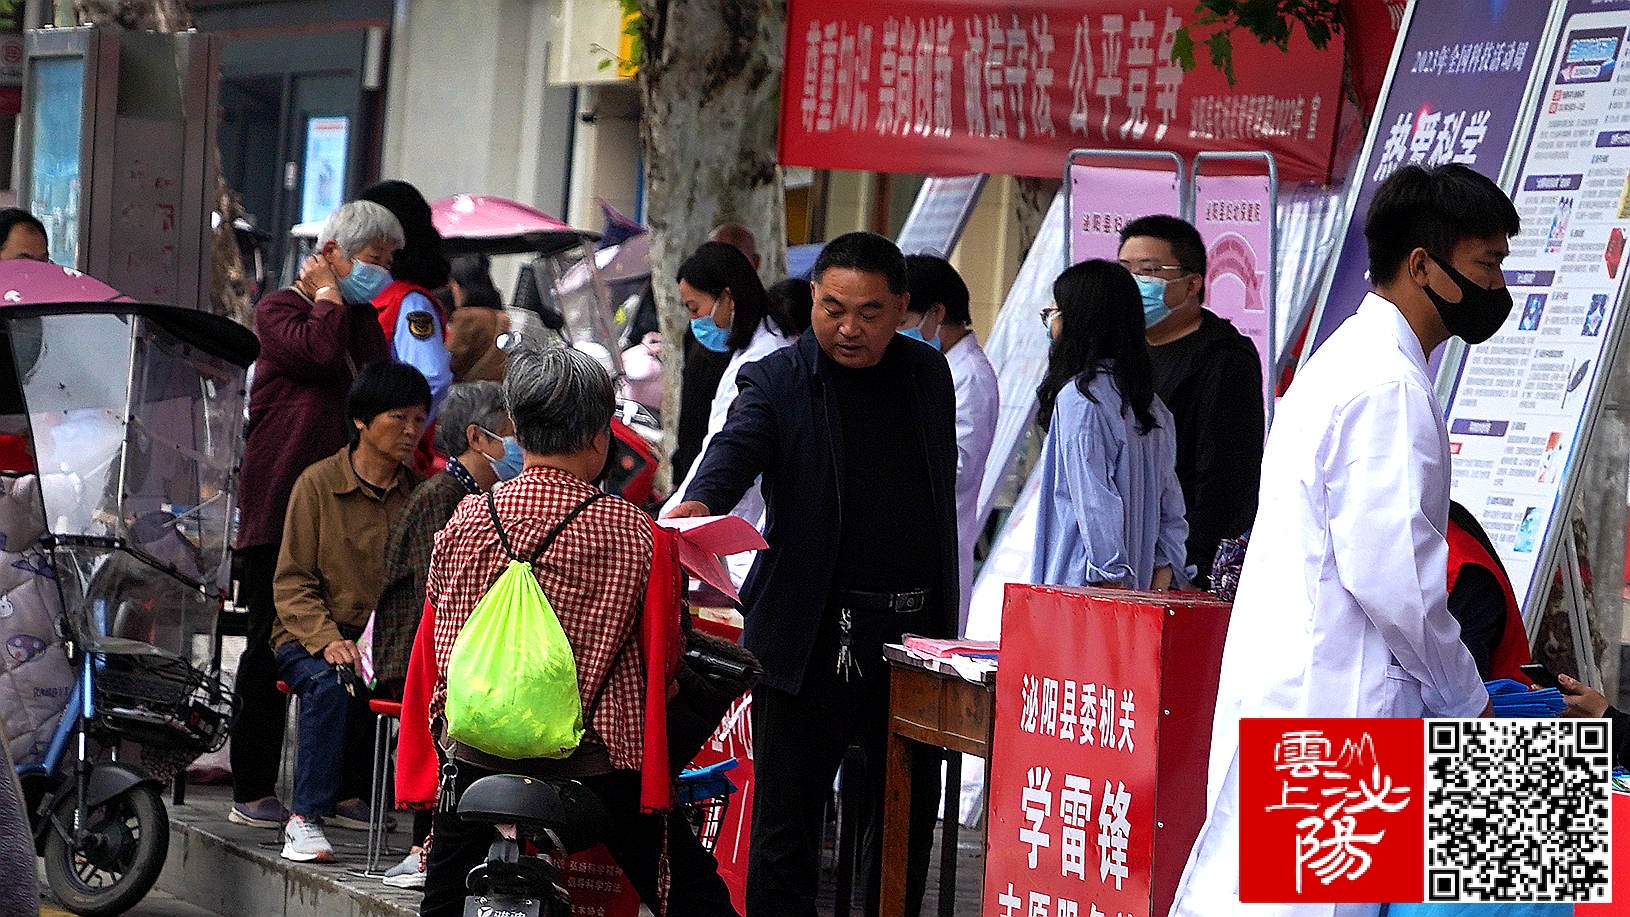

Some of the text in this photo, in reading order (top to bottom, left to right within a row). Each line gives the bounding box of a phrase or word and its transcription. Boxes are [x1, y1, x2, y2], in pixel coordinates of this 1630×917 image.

[1068, 6, 1183, 143] 公平竞争
[1372, 108, 1491, 182] 热爱科学
[1019, 673, 1136, 754] 泌阳县委机关
[1019, 766, 1132, 891] 学雷锋
